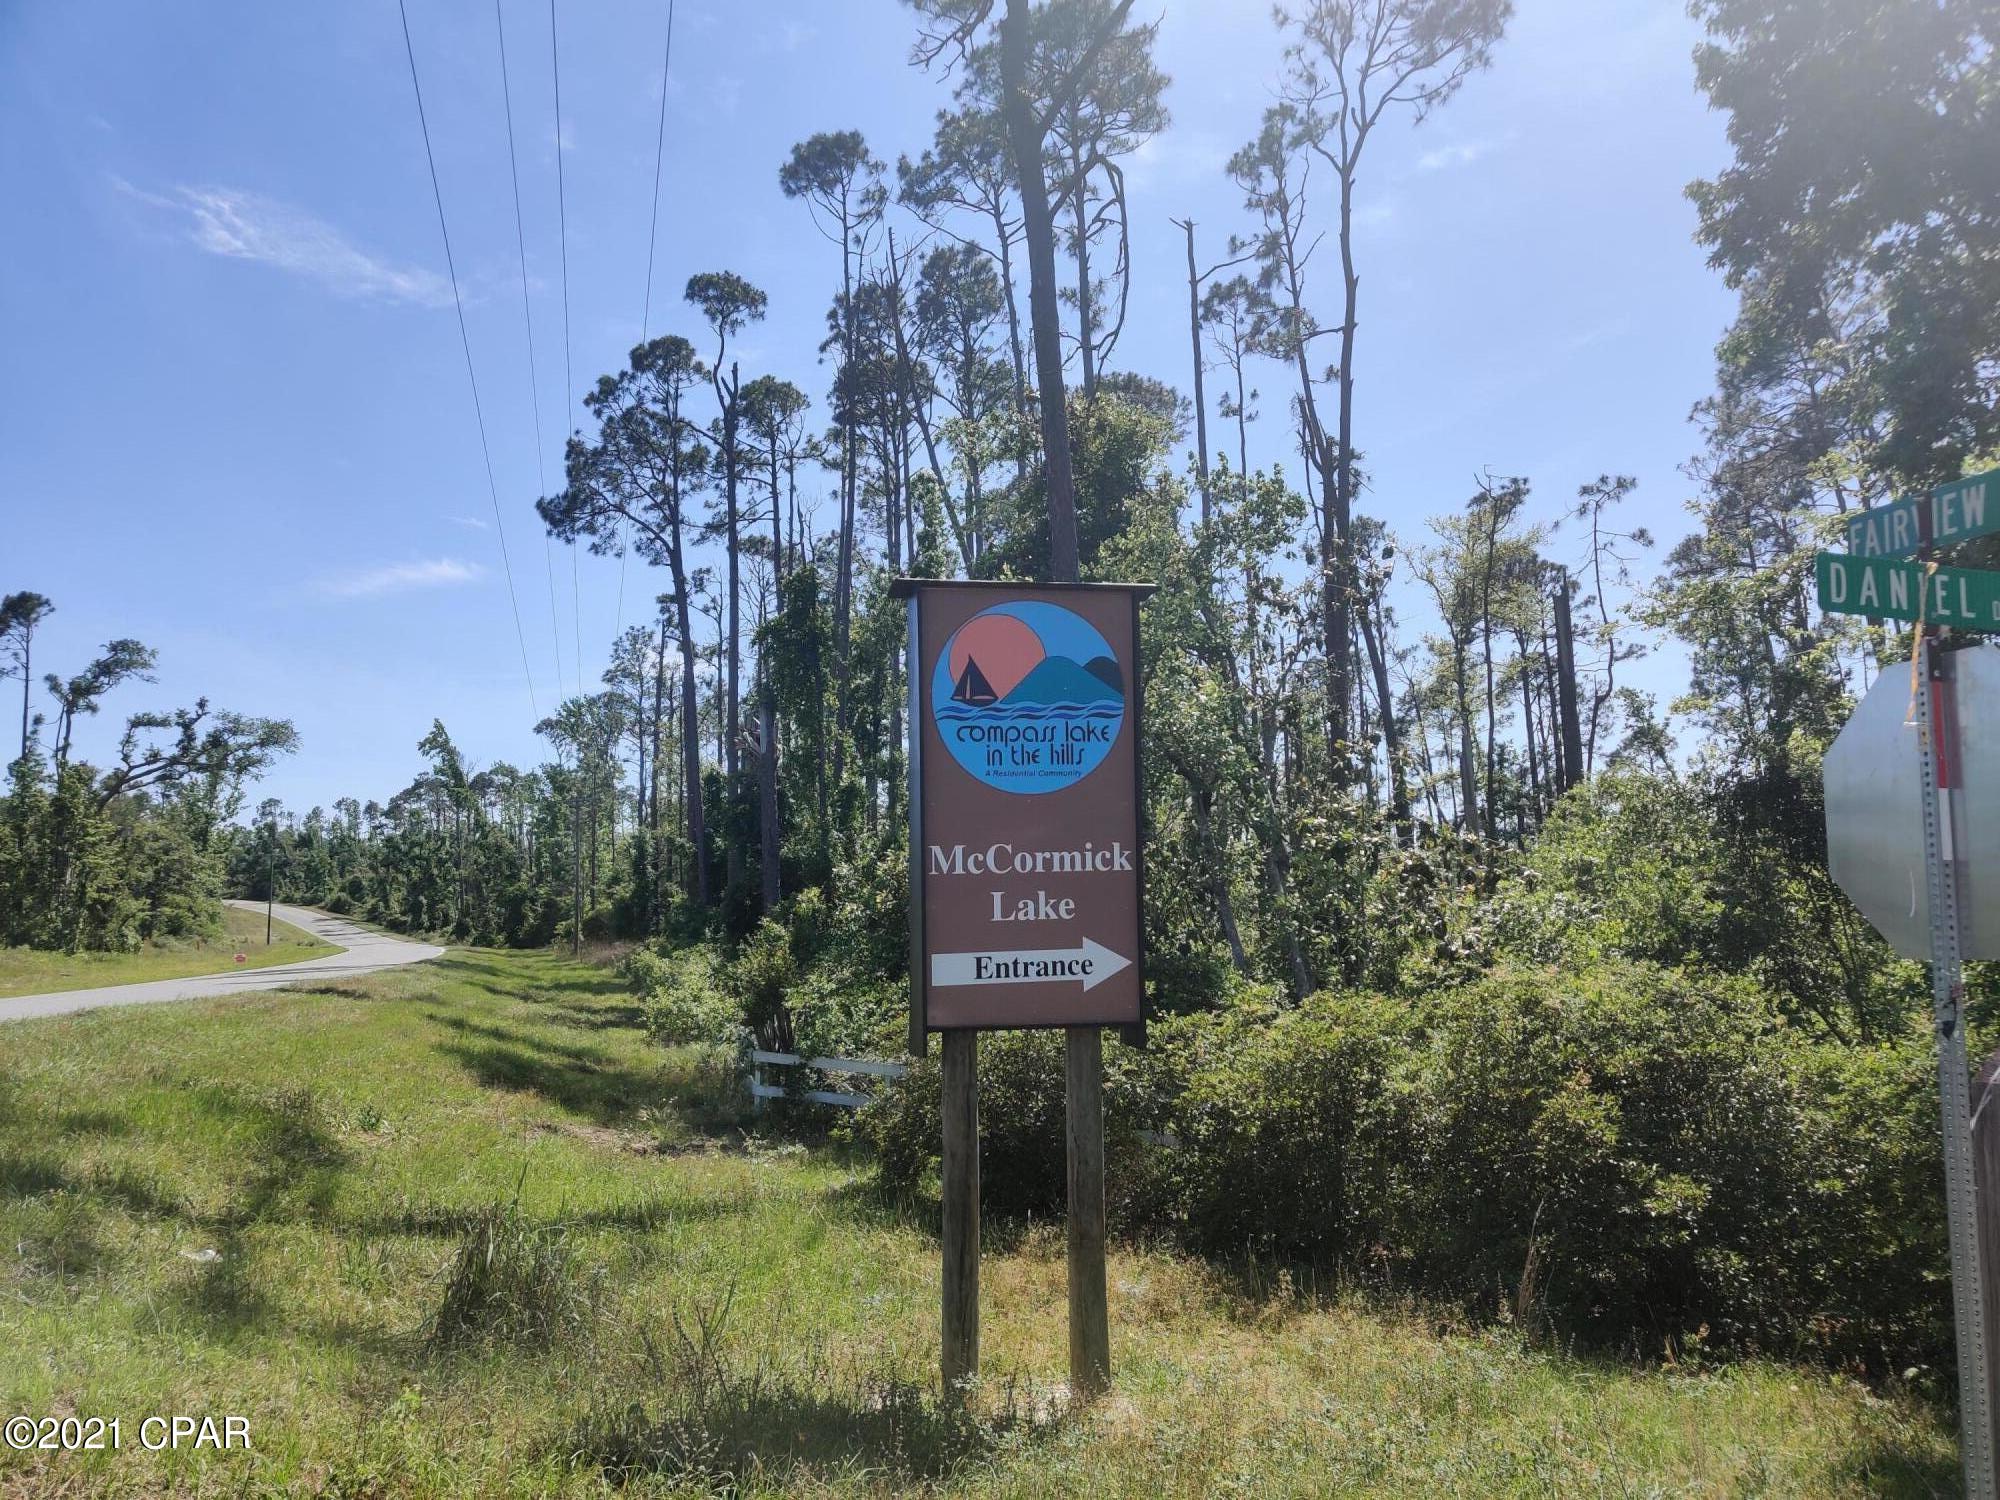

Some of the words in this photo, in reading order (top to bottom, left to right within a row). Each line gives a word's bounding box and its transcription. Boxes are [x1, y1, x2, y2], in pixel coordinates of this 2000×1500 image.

[956, 724, 1057, 747] compass
[1065, 720, 1110, 743] lake
[986, 744, 1003, 766] in
[1011, 743, 1041, 766] the
[1050, 743, 1086, 766] hills
[985, 769, 991, 777] A
[992, 769, 1036, 777] Residential
[1038, 769, 1082, 778] Community
[928, 841, 1133, 875] McCormick
[990, 890, 1076, 922] Lake
[974, 955, 1094, 980] Entrance
